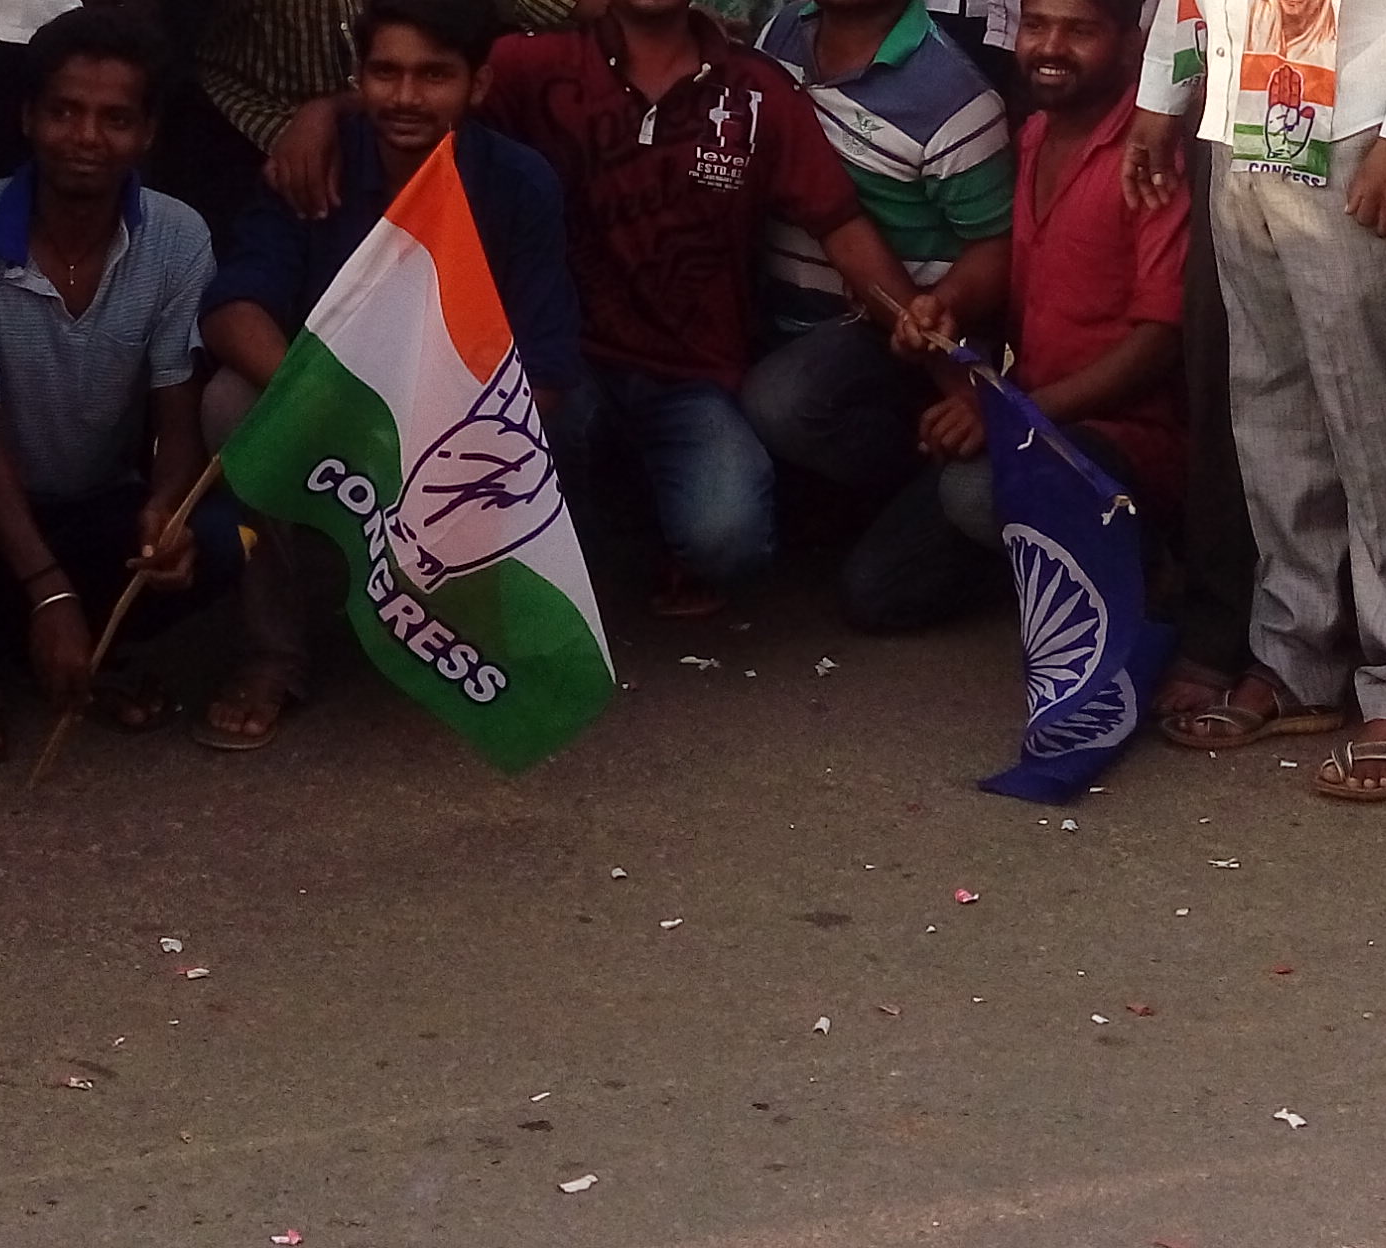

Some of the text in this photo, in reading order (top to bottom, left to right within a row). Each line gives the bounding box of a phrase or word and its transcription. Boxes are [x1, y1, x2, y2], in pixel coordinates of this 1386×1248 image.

[696, 146, 751, 168] level
[1248, 162, 1325, 188] CONGESS
[305, 457, 508, 703] CONGRESS
